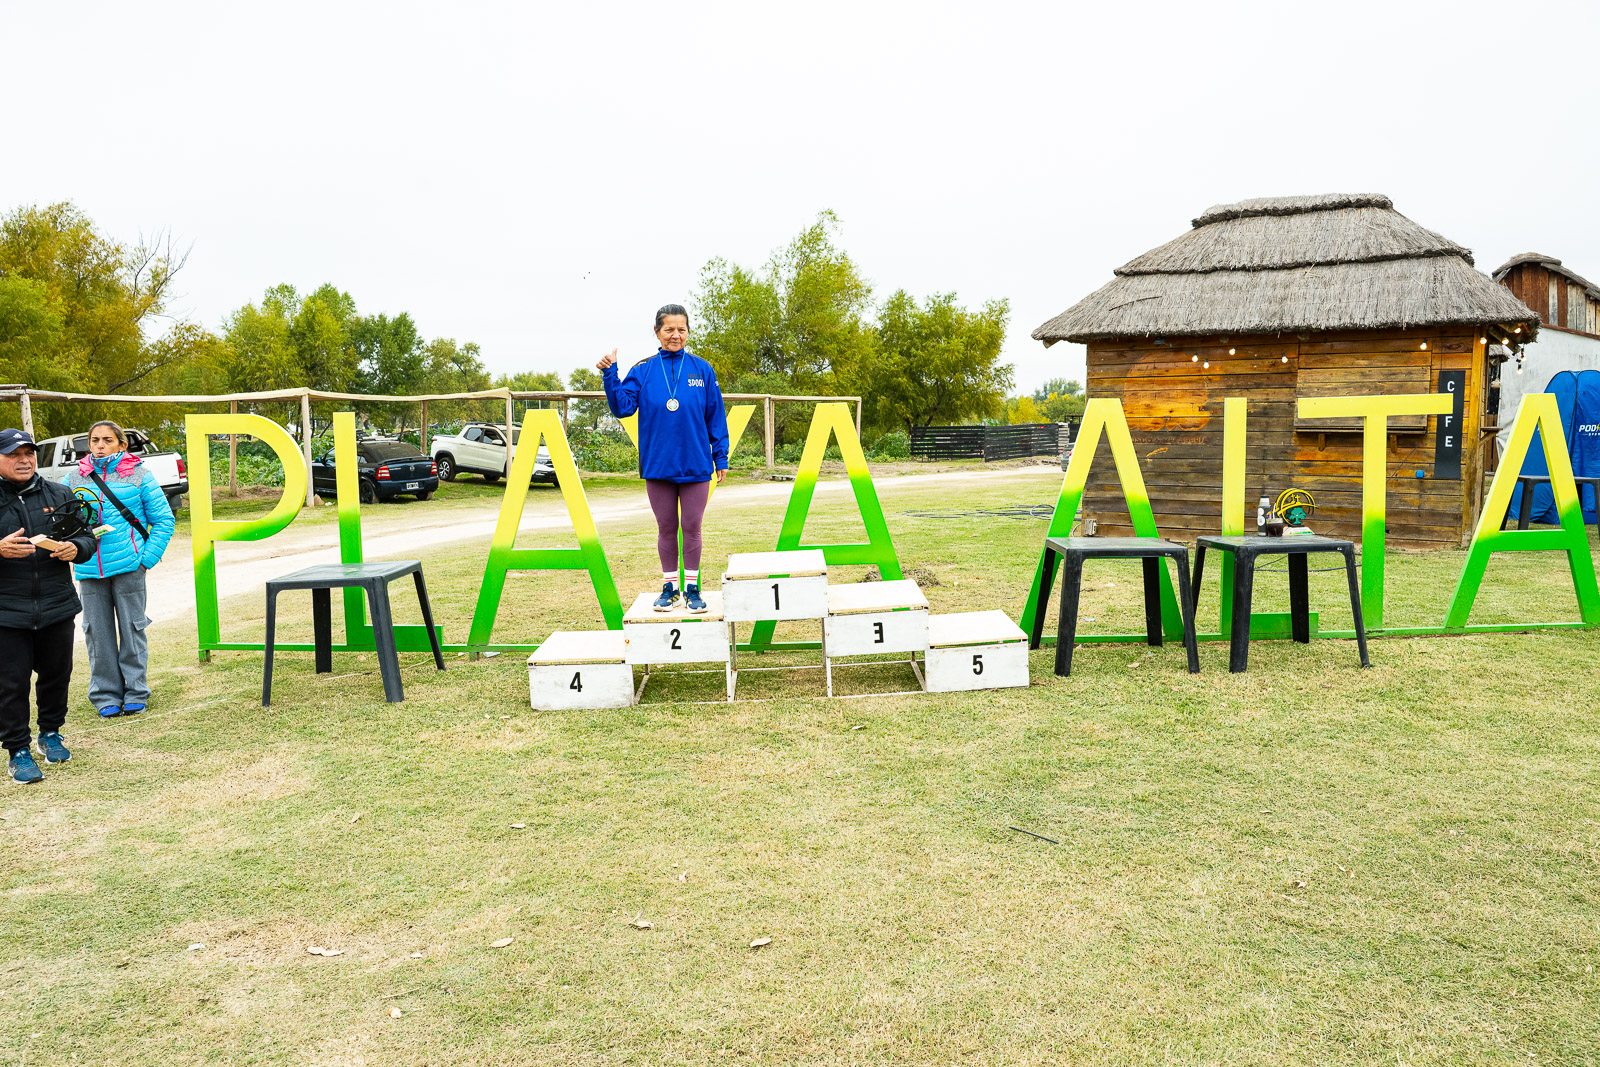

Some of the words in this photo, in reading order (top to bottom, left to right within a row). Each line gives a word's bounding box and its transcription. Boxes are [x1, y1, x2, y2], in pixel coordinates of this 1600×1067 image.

[1445, 381, 1455, 448] CFE
[1020, 393, 1600, 642] ALTA
[771, 583, 781, 611] 1
[669, 628, 682, 650] 2
[873, 621, 885, 644] 3
[972, 654, 984, 676] 5
[569, 671, 583, 693] 4
